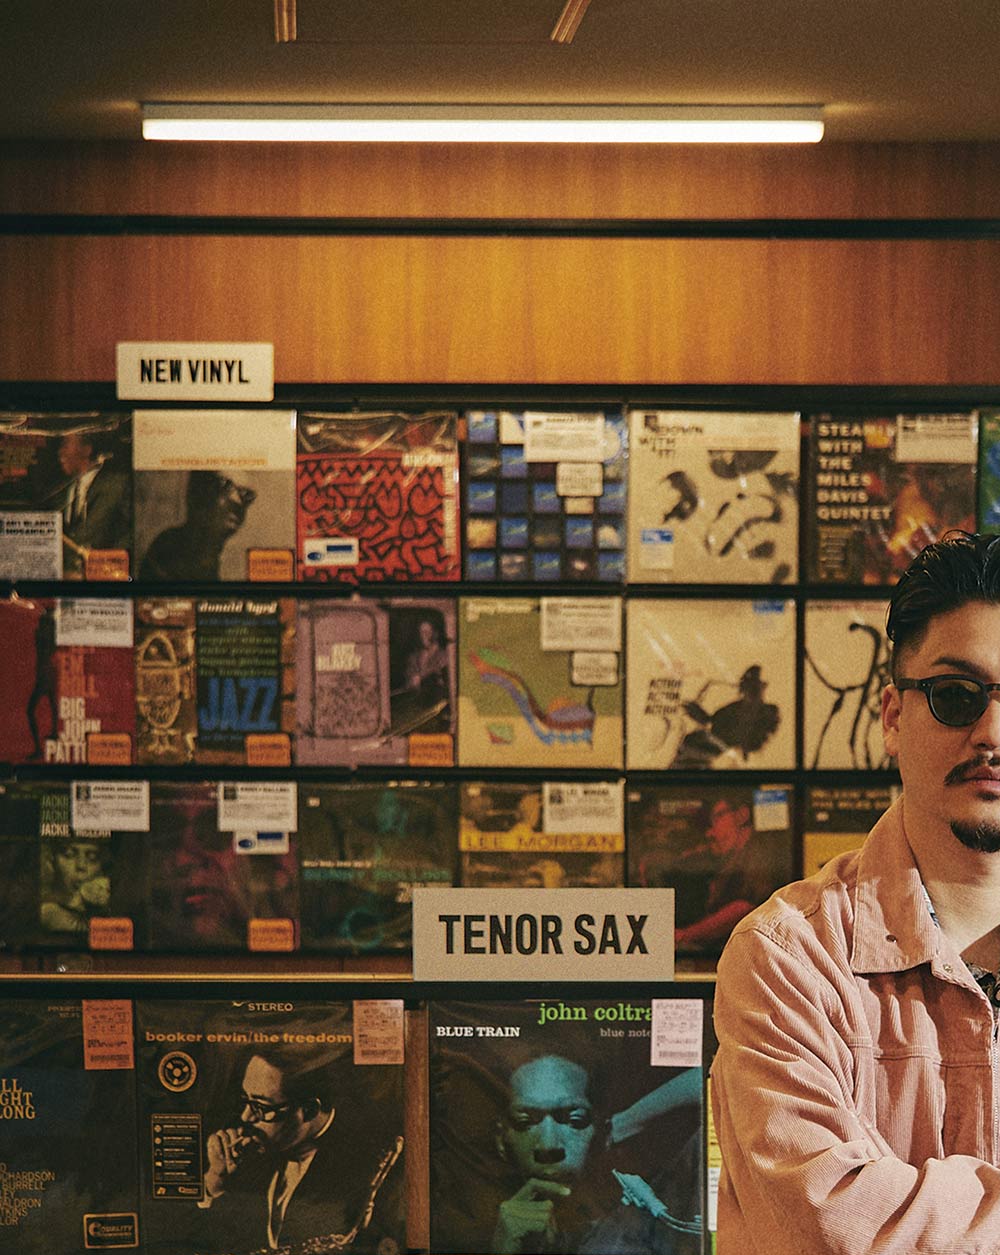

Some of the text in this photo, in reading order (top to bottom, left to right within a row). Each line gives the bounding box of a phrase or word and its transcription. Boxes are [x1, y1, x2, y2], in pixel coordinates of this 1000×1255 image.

[140, 358, 250, 384] NEW VINYL
[817, 440, 863, 454] WITH
[818, 456, 853, 471] THE
[816, 472, 872, 487] MILES
[816, 489, 869, 503] DAVIS
[816, 505, 892, 520] QUINTET
[58, 697, 86, 719] BIG
[199, 676, 278, 731] JAZZ
[465, 836, 617, 850] LEE MORGAN
[438, 913, 649, 956] TENOR SAX
[247, 1002, 294, 1012] STEREO
[537, 1002, 588, 1025] john
[145, 1031, 202, 1043] booker
[283, 1032, 353, 1044] freedom
[436, 1026, 521, 1038] BLUE TRAIN
[599, 1027, 625, 1038] blue
